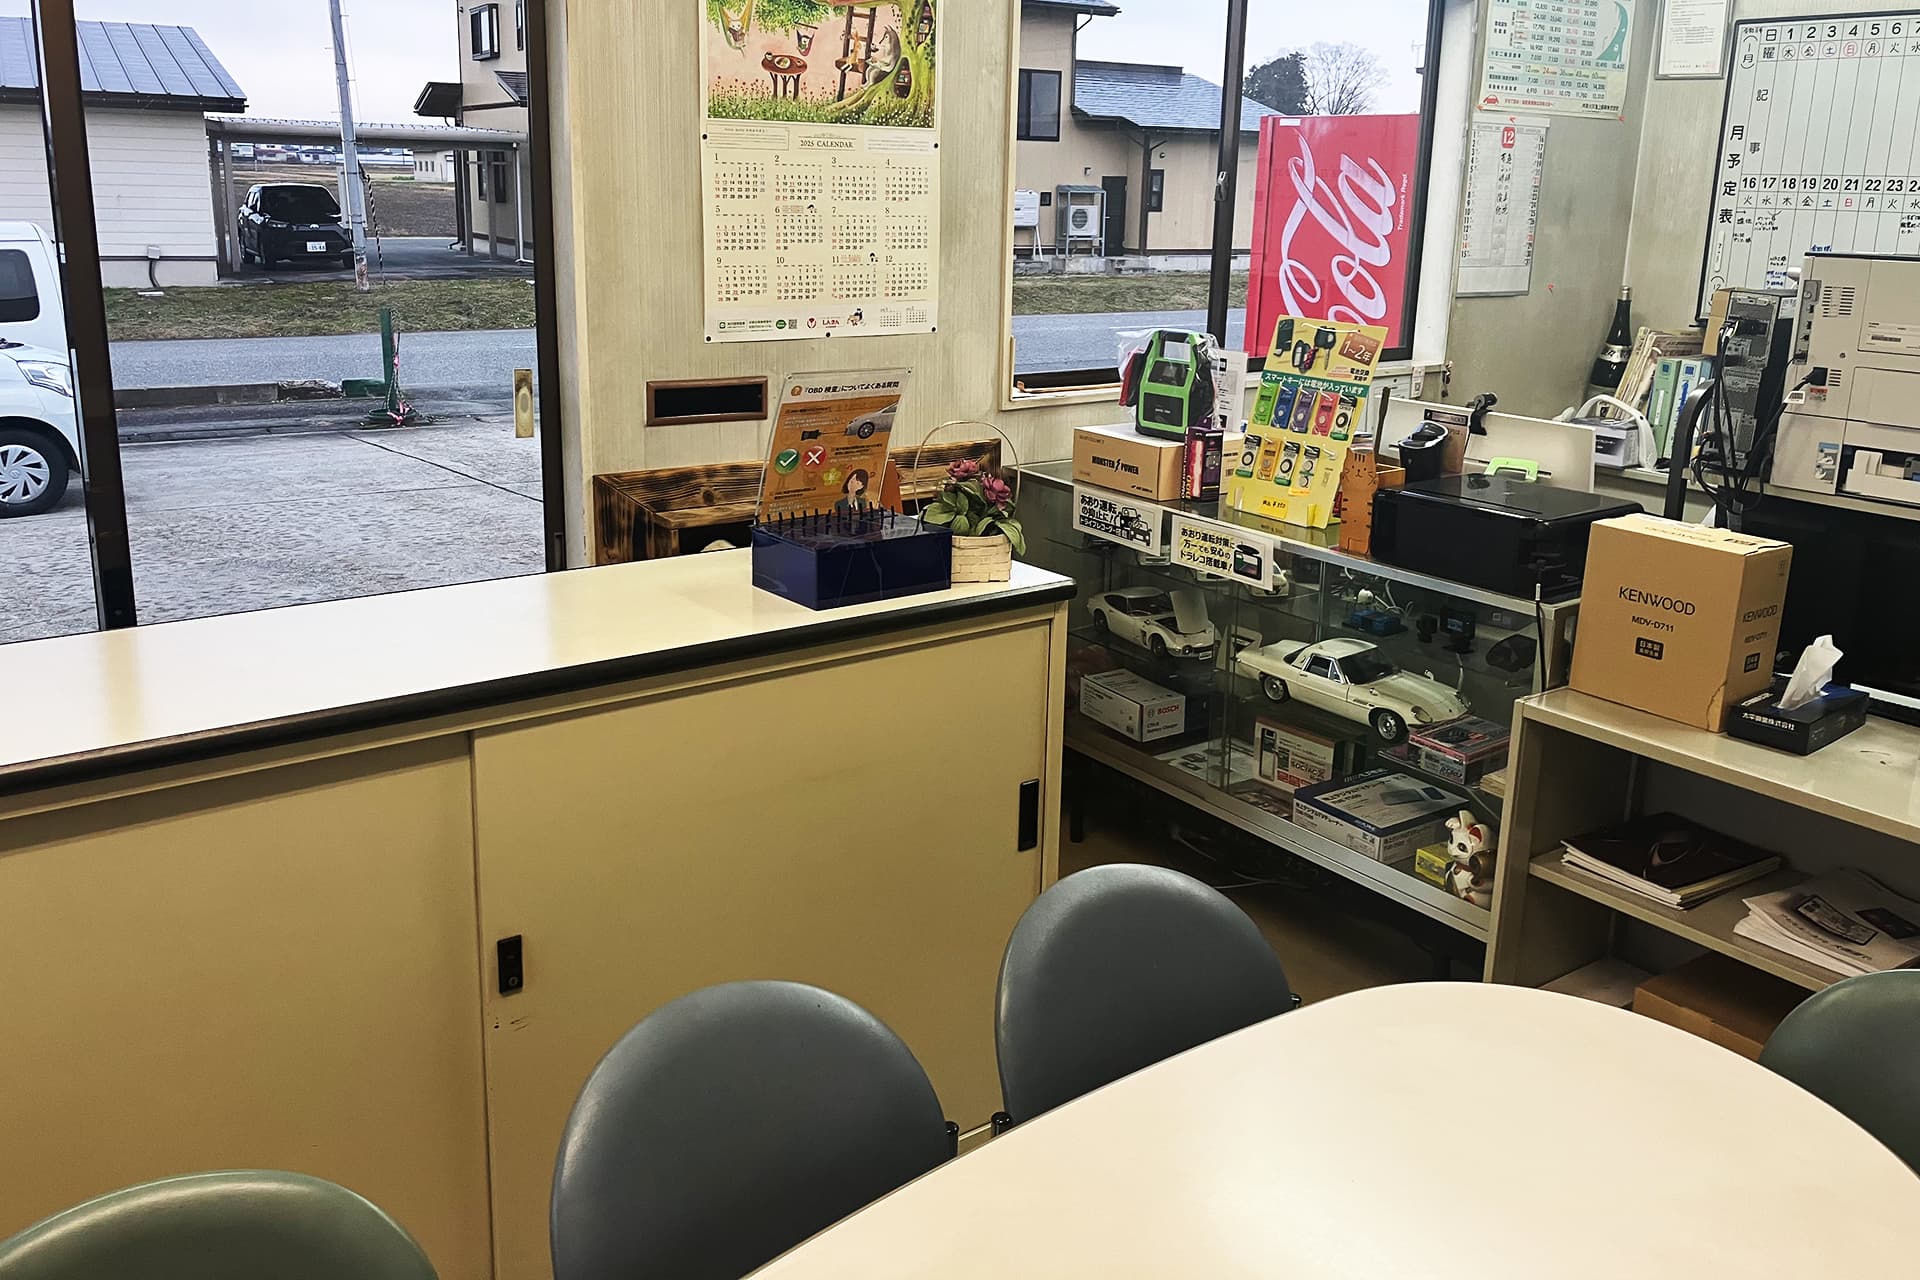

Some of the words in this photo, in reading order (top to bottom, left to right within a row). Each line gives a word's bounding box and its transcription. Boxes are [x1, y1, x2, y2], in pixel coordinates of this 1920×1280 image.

[1787, 28, 1794, 40] 1
[1806, 26, 1816, 38] 2
[1827, 26, 1836, 38] 3
[1848, 24, 1858, 36] 4
[1870, 24, 1880, 36] 5
[1892, 22, 1902, 34] 6
[1868, 42, 1876, 54] 月
[1890, 42, 1900, 54] 火
[816, 140, 854, 149] CALENDAR
[1503, 130, 1514, 144] 12
[1742, 177, 1757, 190] 16
[1762, 177, 1776, 190] 17
[1781, 178, 1796, 190] 18
[1802, 178, 1816, 190] 19
[1822, 178, 1838, 190] 20
[1844, 179, 1859, 190] 21
[1864, 180, 1882, 192] 22
[1886, 180, 1904, 192] 23
[1743, 196, 1752, 206] 火
[1762, 195, 1772, 206] 水
[1802, 196, 1814, 206] 金
[1822, 200, 1832, 208] 土
[1844, 198, 1852, 208] 日
[1866, 197, 1875, 208] 月
[1888, 199, 1898, 209] 火
[716, 256, 722, 264] 9
[1092, 455, 1115, 468] MONSTER
[1120, 464, 1140, 475] POWER
[1080, 495, 1117, 514] あおり運転
[1181, 528, 1235, 550] あおり運転対策に
[1619, 586, 1696, 615] KENWOOD
[1743, 605, 1778, 622] KENWOOD
[1632, 616, 1674, 632] MDV-D711
[1158, 704, 1180, 714] BOSCH
